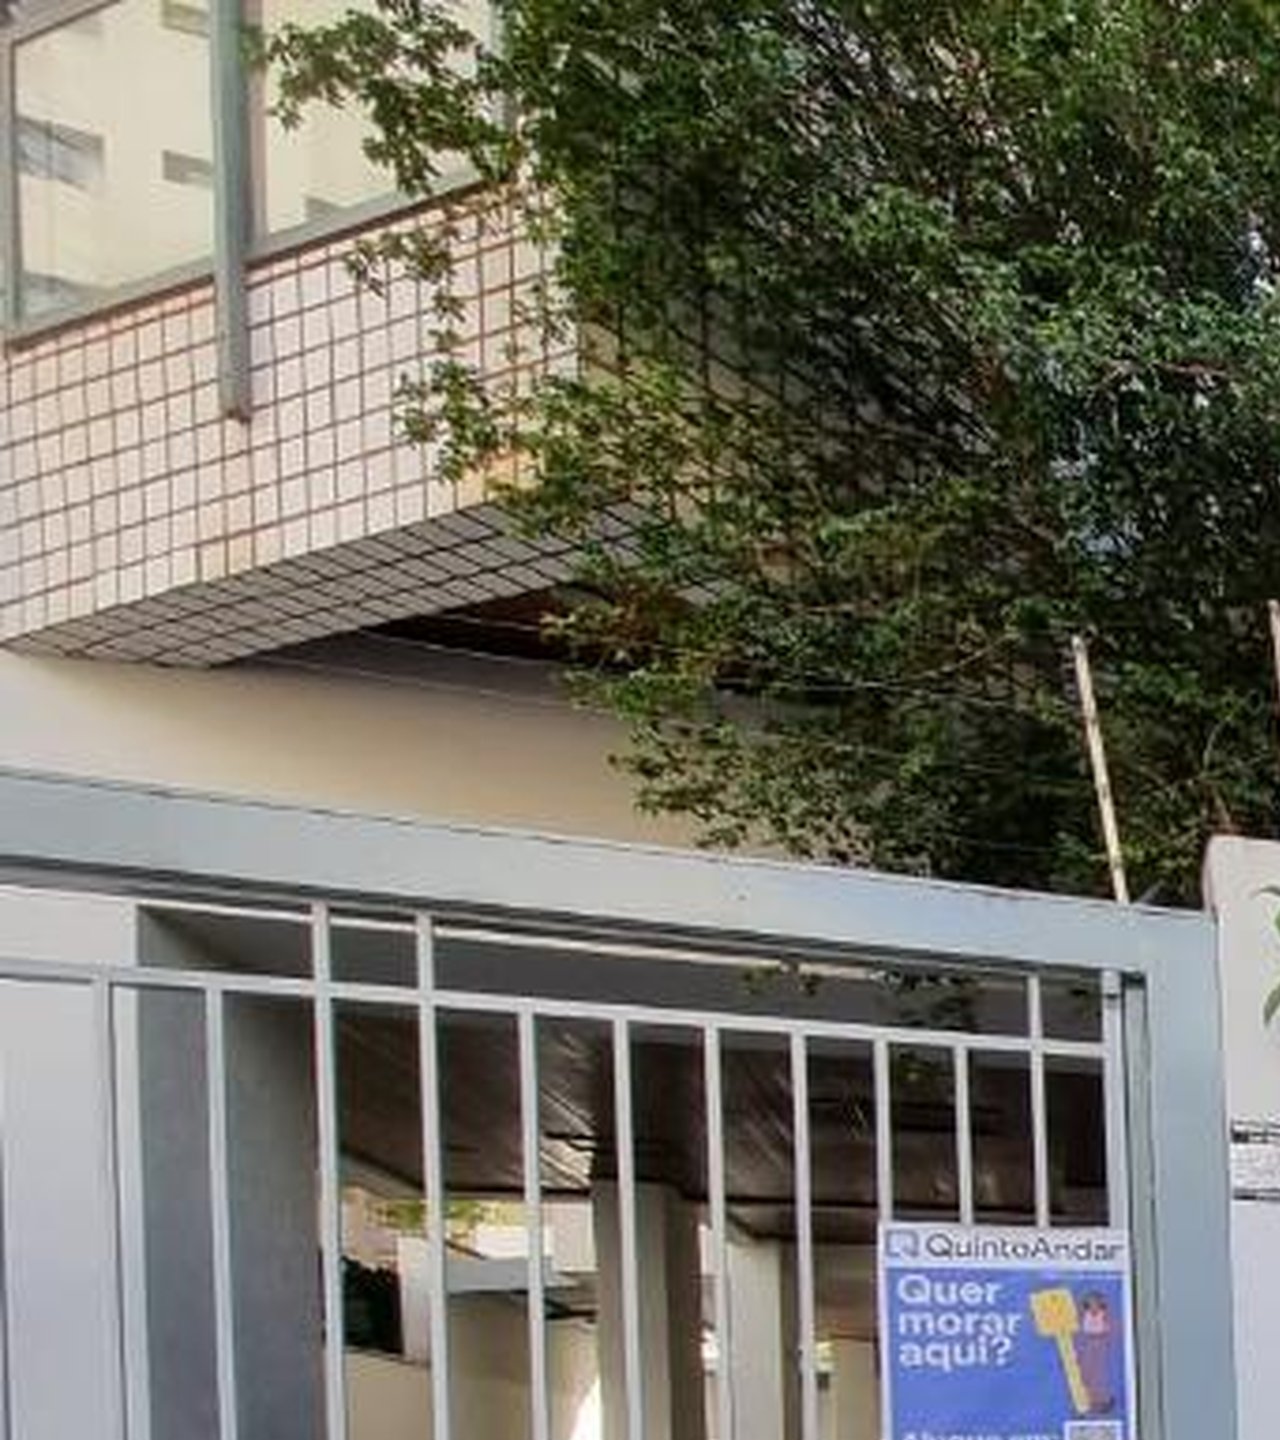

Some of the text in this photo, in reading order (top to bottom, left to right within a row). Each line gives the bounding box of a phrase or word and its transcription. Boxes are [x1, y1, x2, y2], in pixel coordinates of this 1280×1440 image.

[926, 1233, 1123, 1261] QuintoAndar
[897, 1274, 1001, 1304] Quer
[898, 1312, 1021, 1336] morar
[898, 1337, 1012, 1371] aqui?
